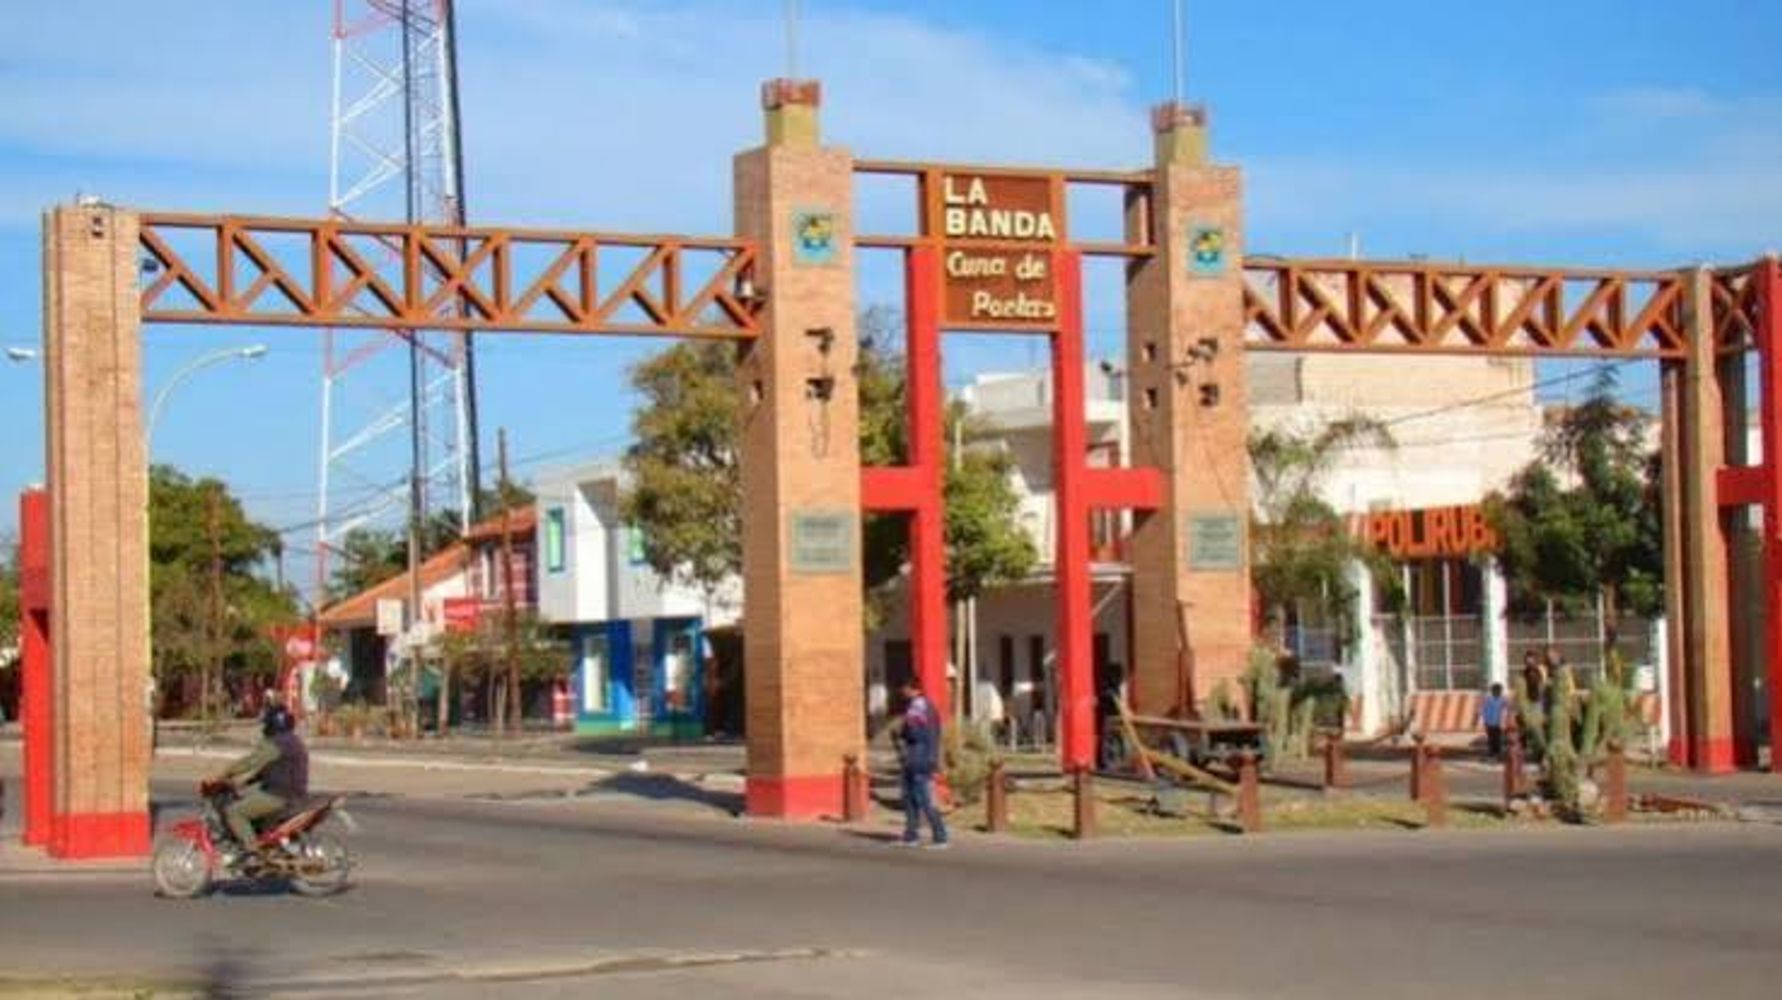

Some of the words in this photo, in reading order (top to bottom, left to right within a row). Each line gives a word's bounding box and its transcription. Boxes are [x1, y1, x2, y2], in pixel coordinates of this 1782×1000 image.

[944, 176, 988, 205] LA
[945, 206, 1056, 239] BANDA
[947, 250, 1007, 277] Cuna
[1015, 253, 1046, 280] de
[971, 290, 1056, 318] Poetas
[1367, 505, 1497, 557] POLIRUB
